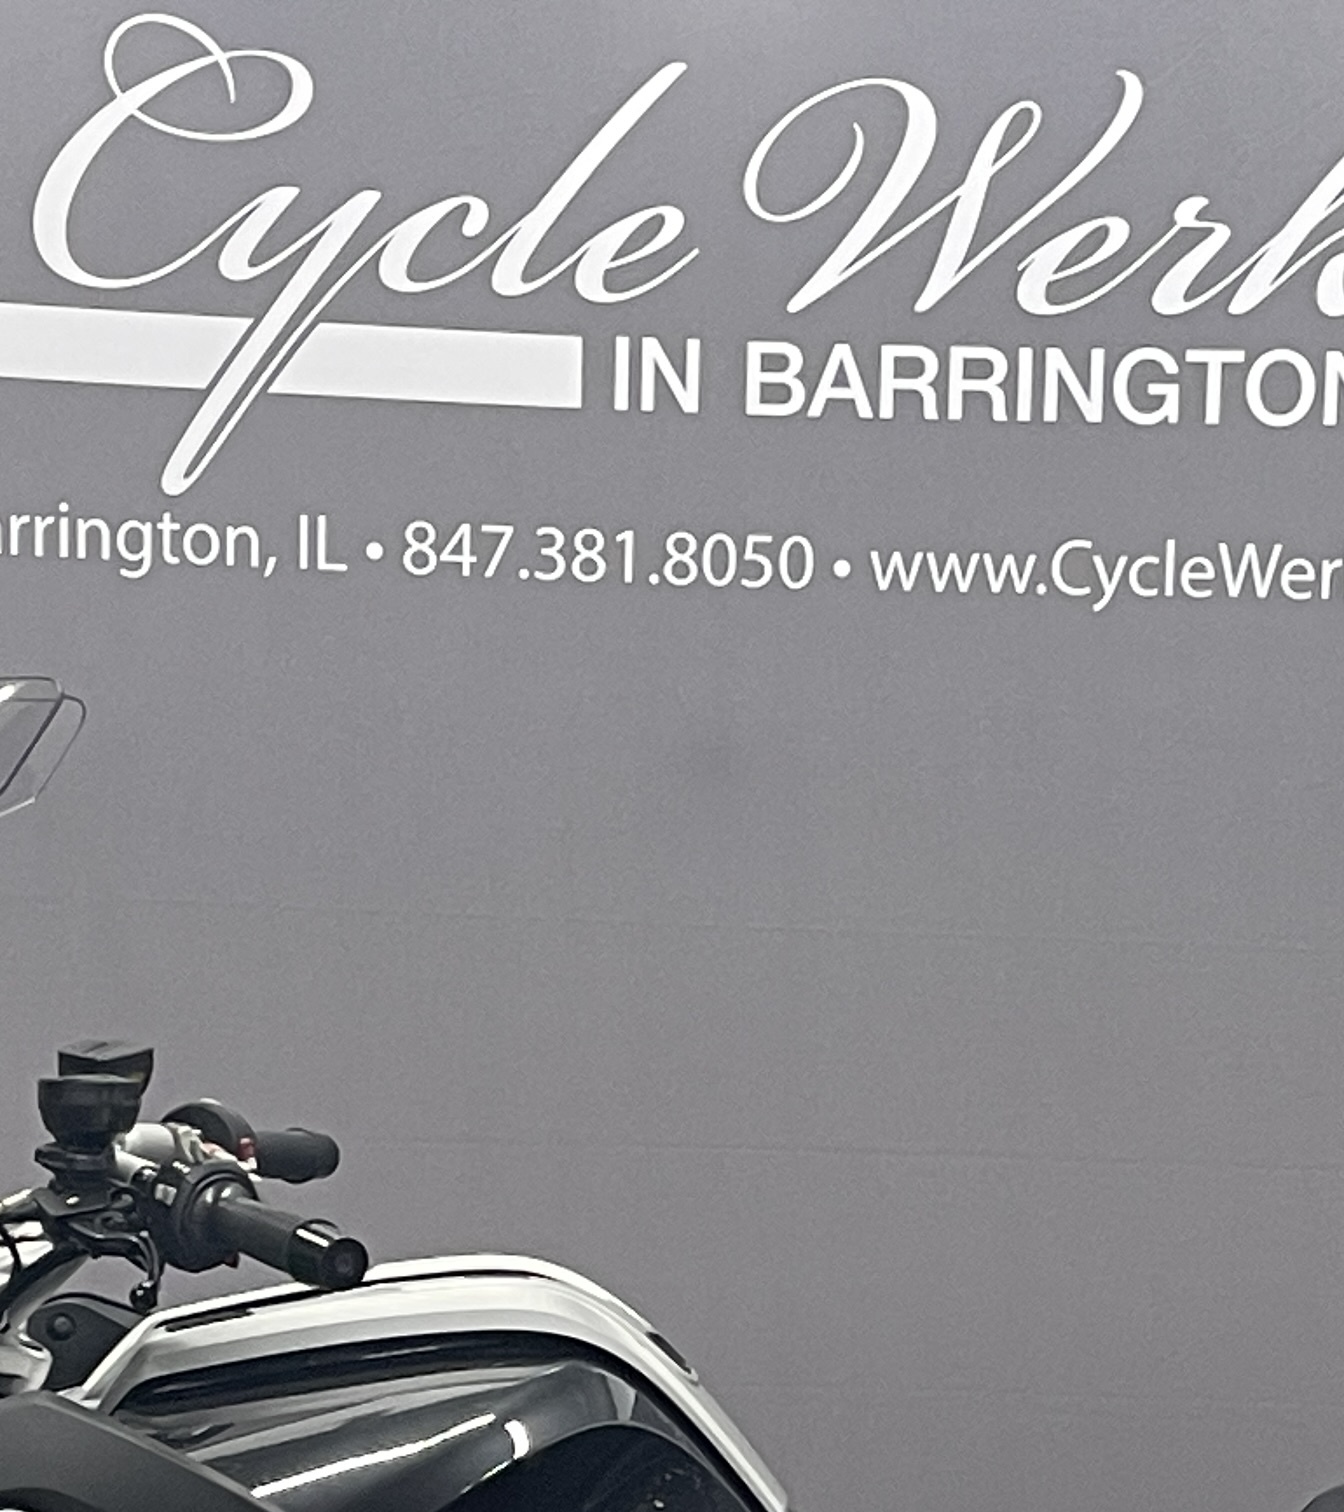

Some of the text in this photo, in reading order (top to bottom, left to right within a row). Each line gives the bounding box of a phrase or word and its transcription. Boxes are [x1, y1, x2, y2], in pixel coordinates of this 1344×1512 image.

[32, 13, 700, 496] Cycle
[613, 336, 701, 414] IN
[299, 514, 348, 572] IL
[402, 521, 814, 590] 847.381.8050
